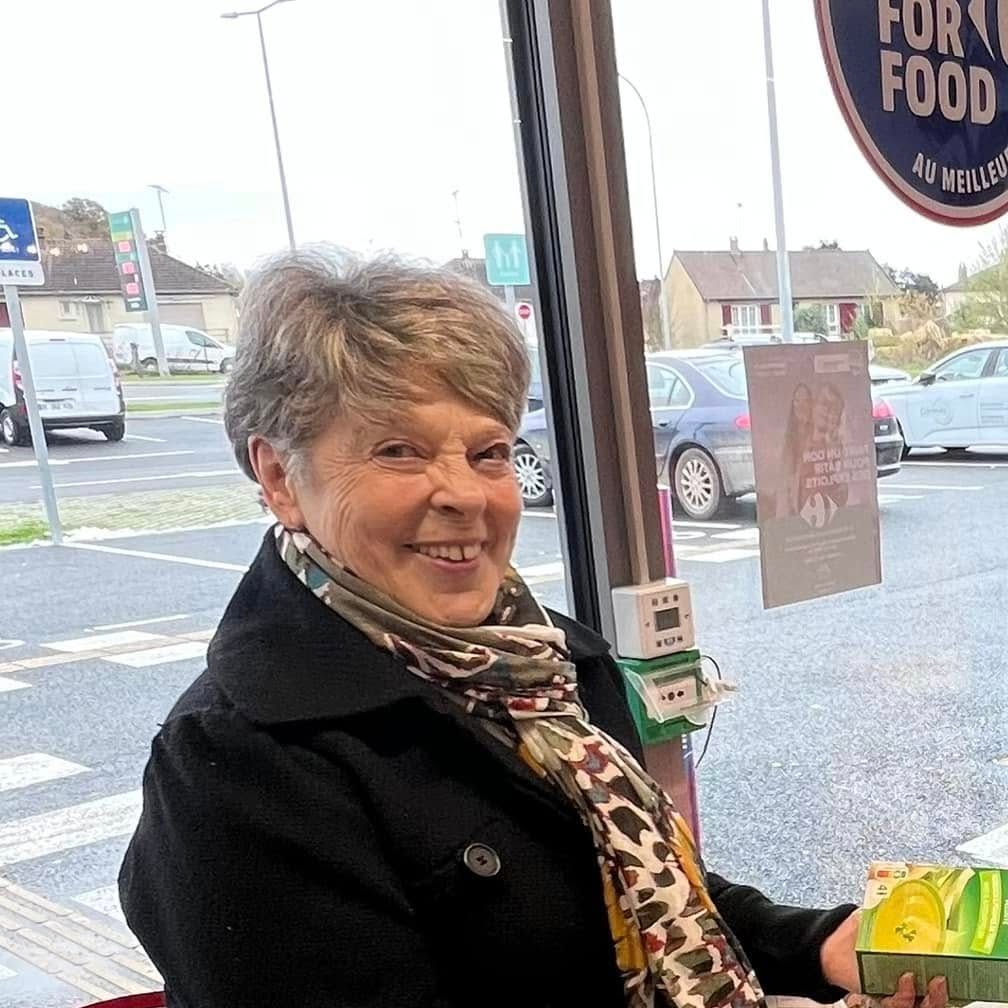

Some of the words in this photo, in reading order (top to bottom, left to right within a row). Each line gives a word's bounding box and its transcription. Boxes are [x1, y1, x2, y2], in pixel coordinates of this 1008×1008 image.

[879, 0, 965, 58] FOR
[880, 49, 997, 124] FOOD
[912, 152, 937, 184] AU
